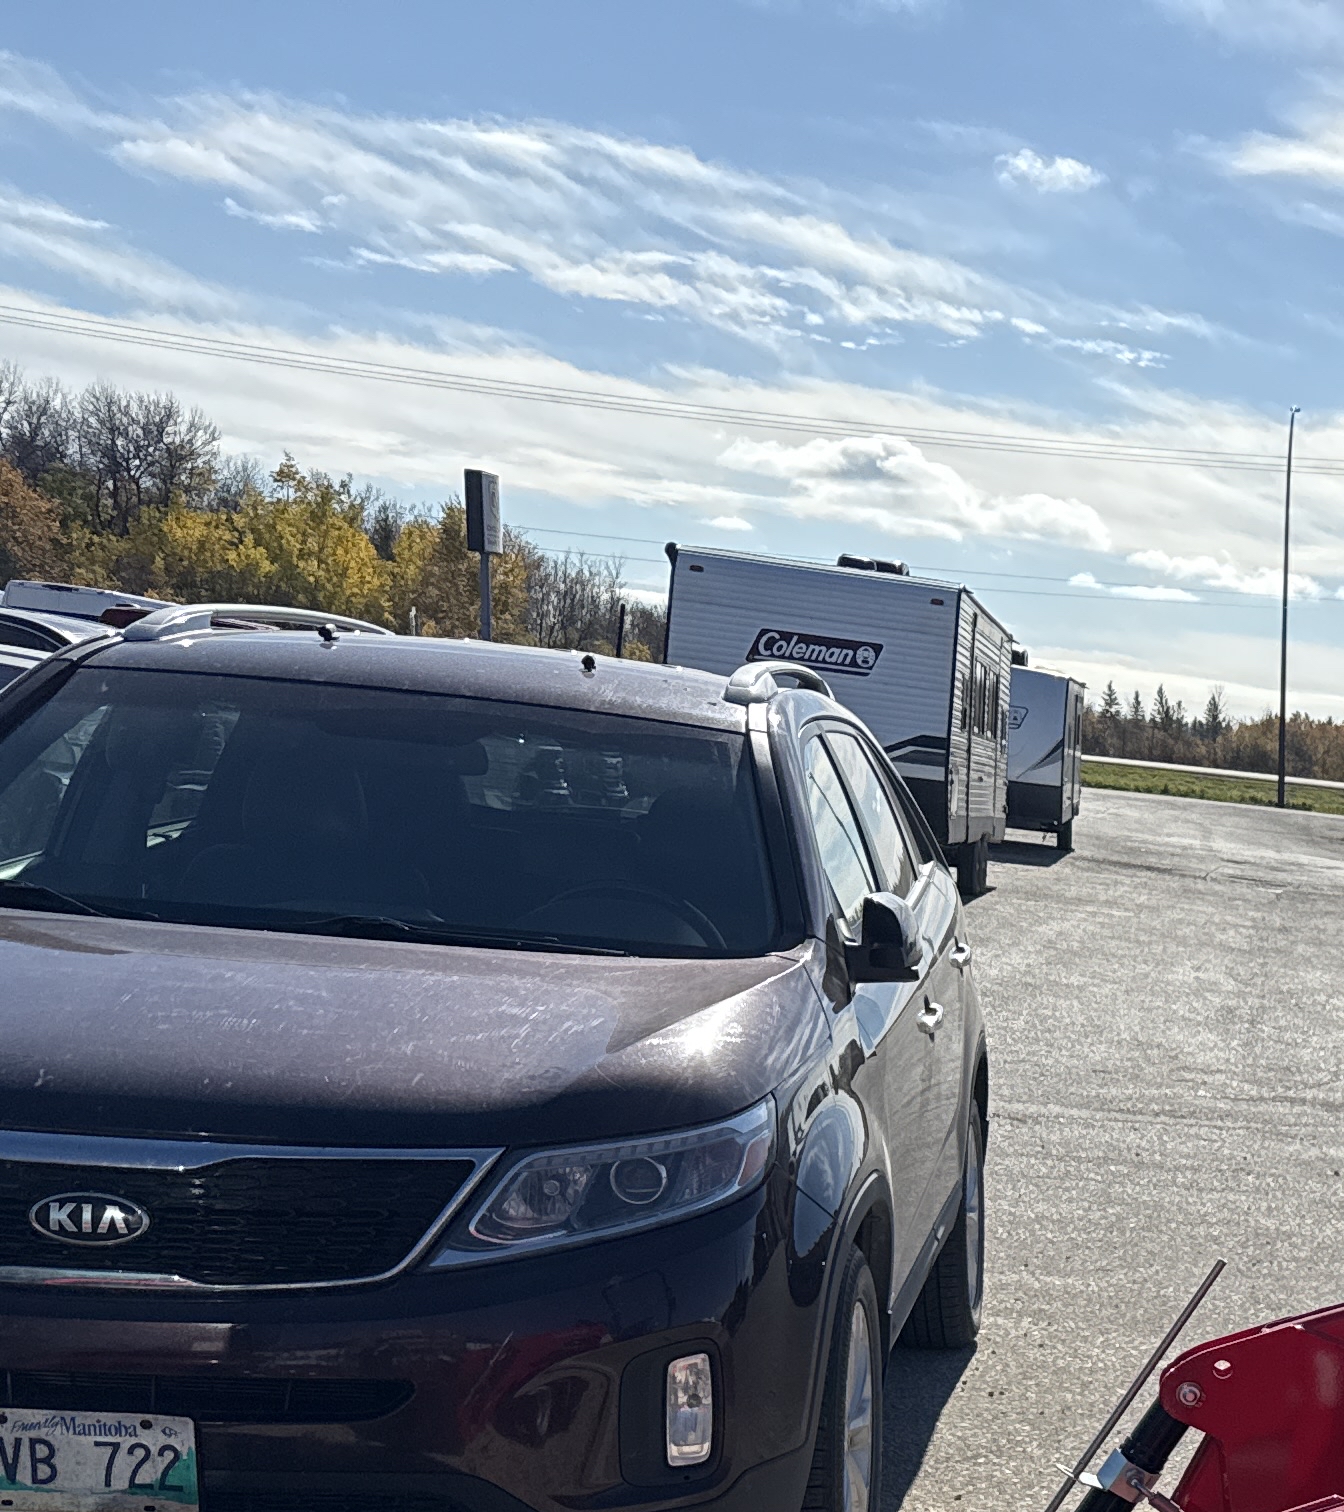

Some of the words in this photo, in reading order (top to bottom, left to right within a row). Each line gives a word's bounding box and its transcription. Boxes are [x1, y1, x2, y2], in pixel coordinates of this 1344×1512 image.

[758, 631, 854, 665] Coleman
[48, 1201, 129, 1234] KIA
[59, 1415, 140, 1439] Manitoba
[93, 1440, 184, 1493] 722
